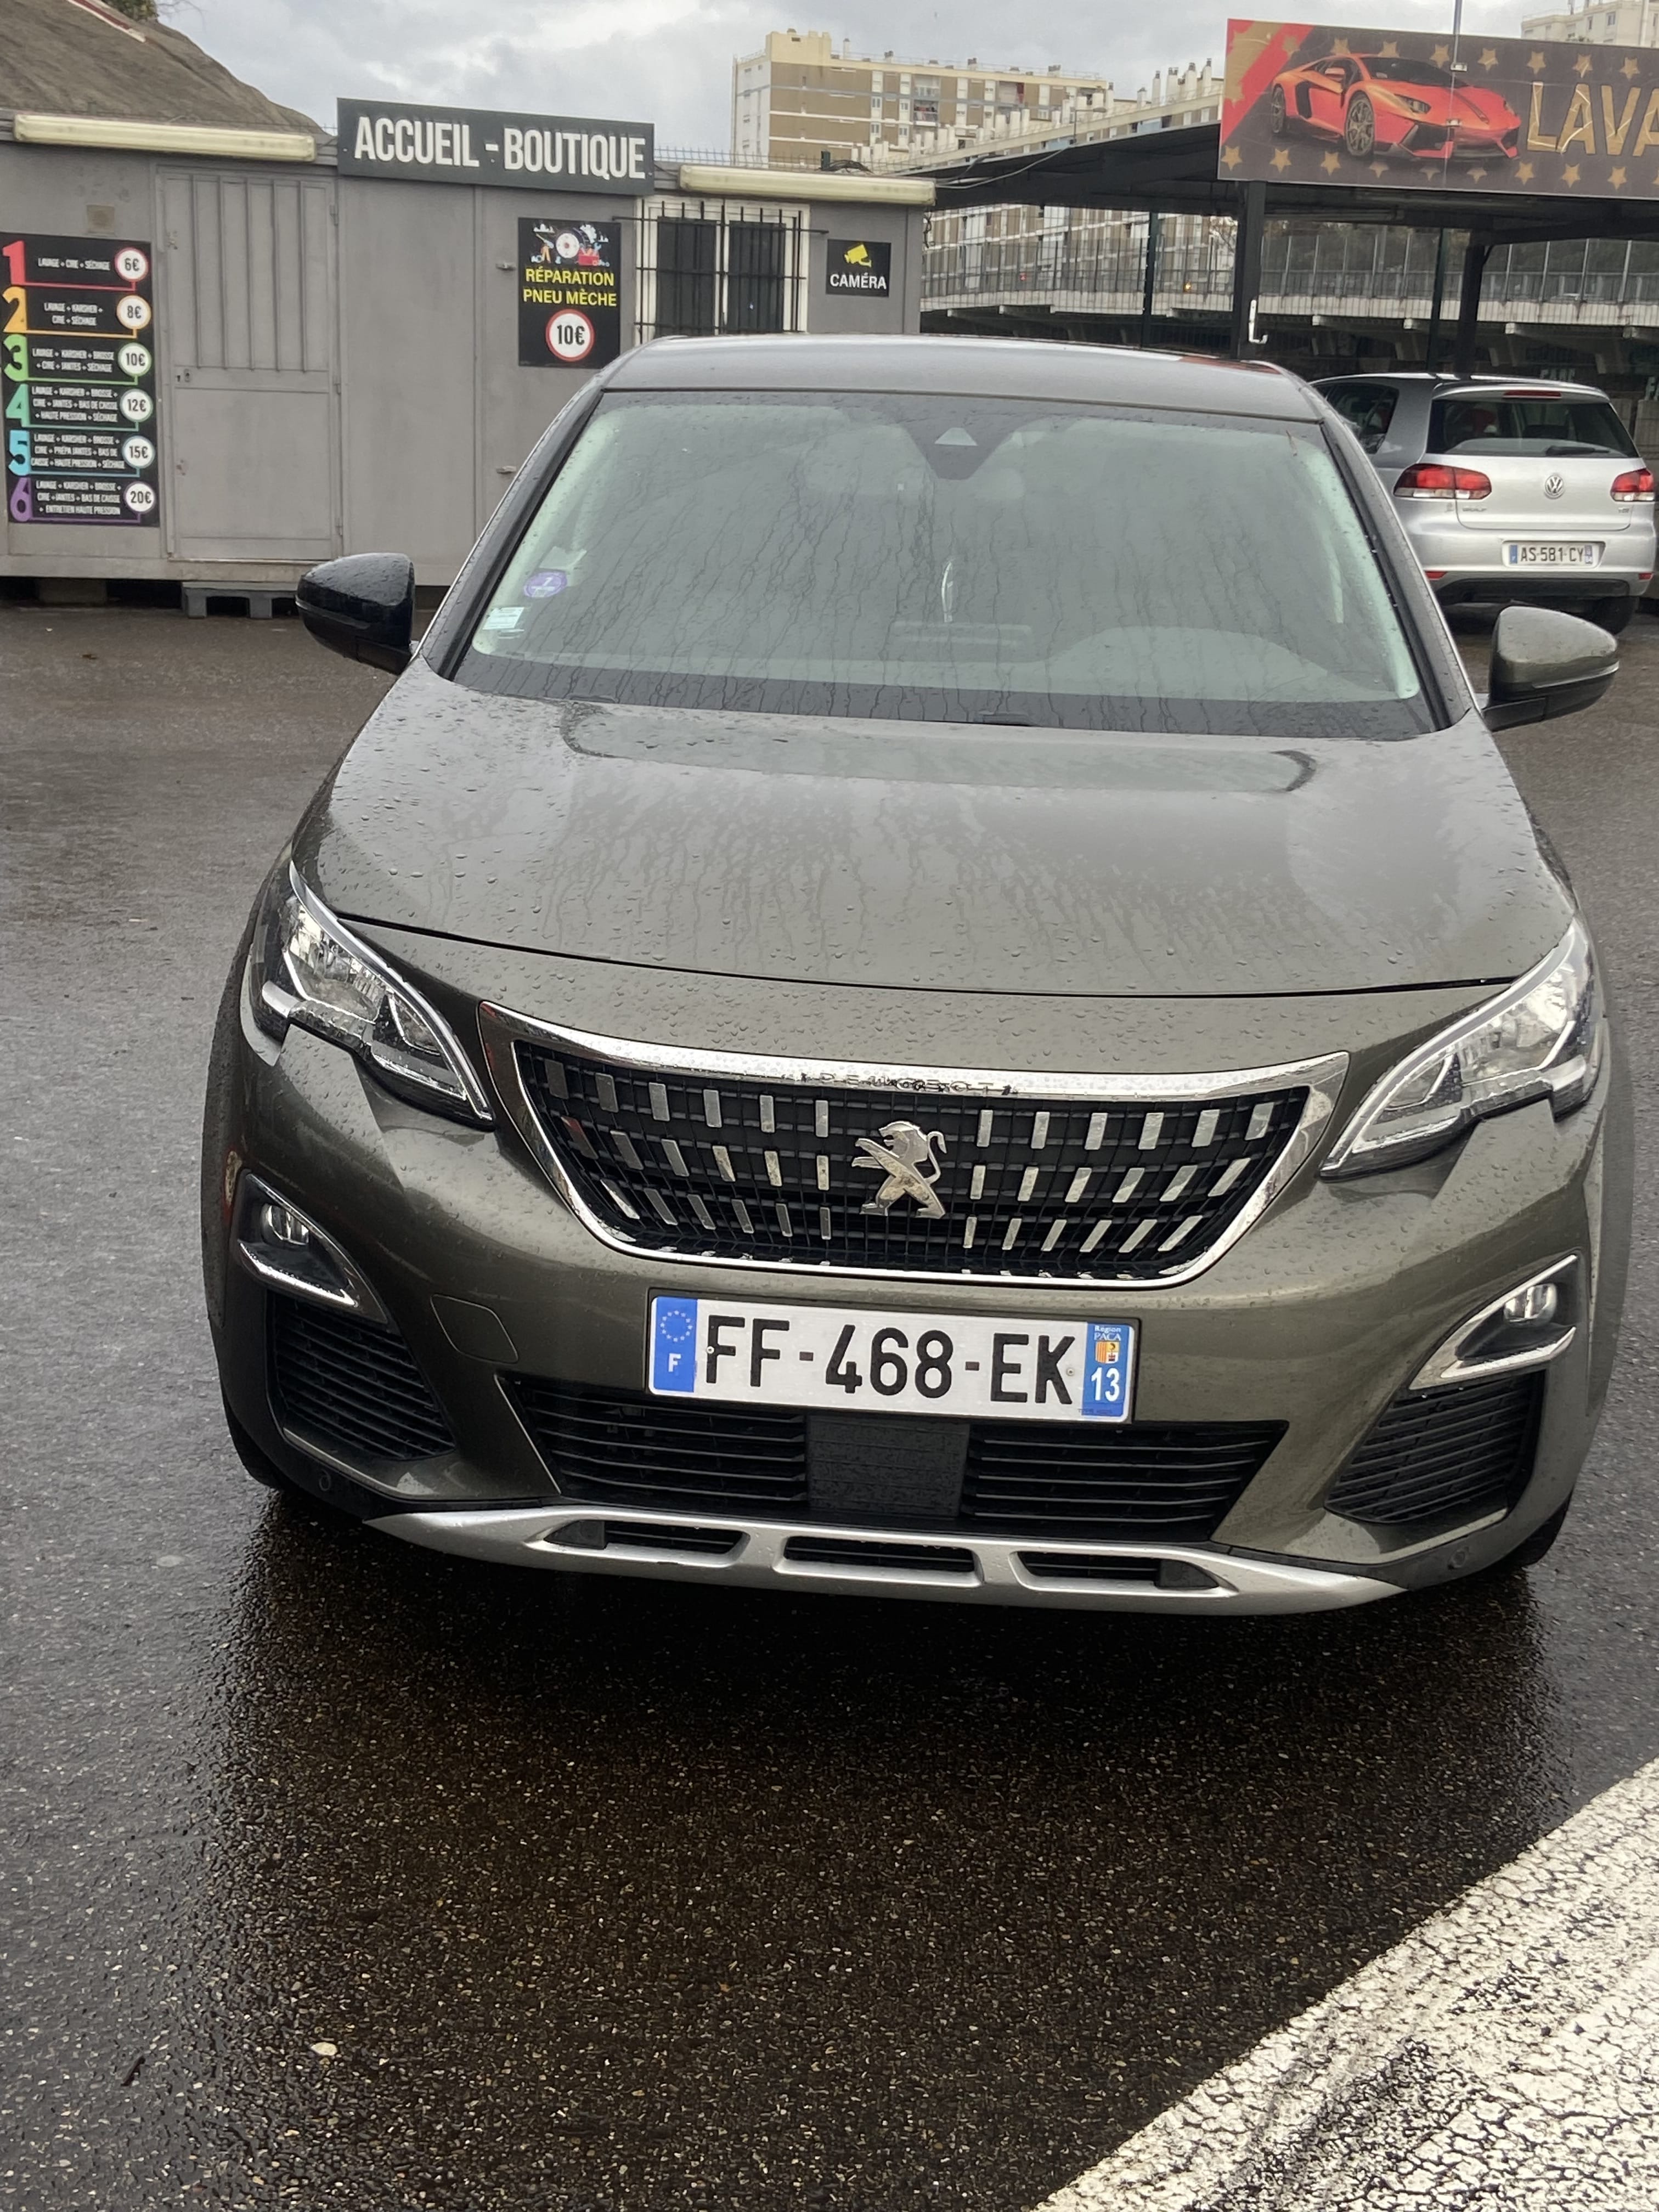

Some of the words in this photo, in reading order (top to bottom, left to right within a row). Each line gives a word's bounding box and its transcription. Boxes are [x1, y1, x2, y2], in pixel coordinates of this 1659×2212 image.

[1527, 82, 1659, 156] LAVA
[354, 116, 480, 168] ACCUEIL
[504, 127, 646, 180] BOUTIQUE
[2, 240, 25, 285] 1
[125, 258, 139, 272] 6€
[525, 266, 614, 287] RÉPARATION
[830, 272, 887, 290] CAMÉRA
[523, 288, 563, 304] PNEU
[566, 286, 617, 307] MÈCHE
[2, 286, 26, 333] 2
[127, 305, 142, 319] 8€
[556, 324, 585, 346] 10€
[3, 334, 27, 382] 3
[126, 353, 145, 366] 10€
[5, 383, 30, 428] 4
[127, 399, 146, 412] 12€
[9, 430, 30, 476] 5
[129, 445, 148, 459] 15€
[10, 477, 32, 521] 6
[130, 490, 152, 504] 20€
[1094, 1332, 1121, 1341] PACA
[668, 1352, 681, 1373] F
[706, 1314, 1076, 1405] FF-468-EK
[1091, 1367, 1120, 1402] 13
